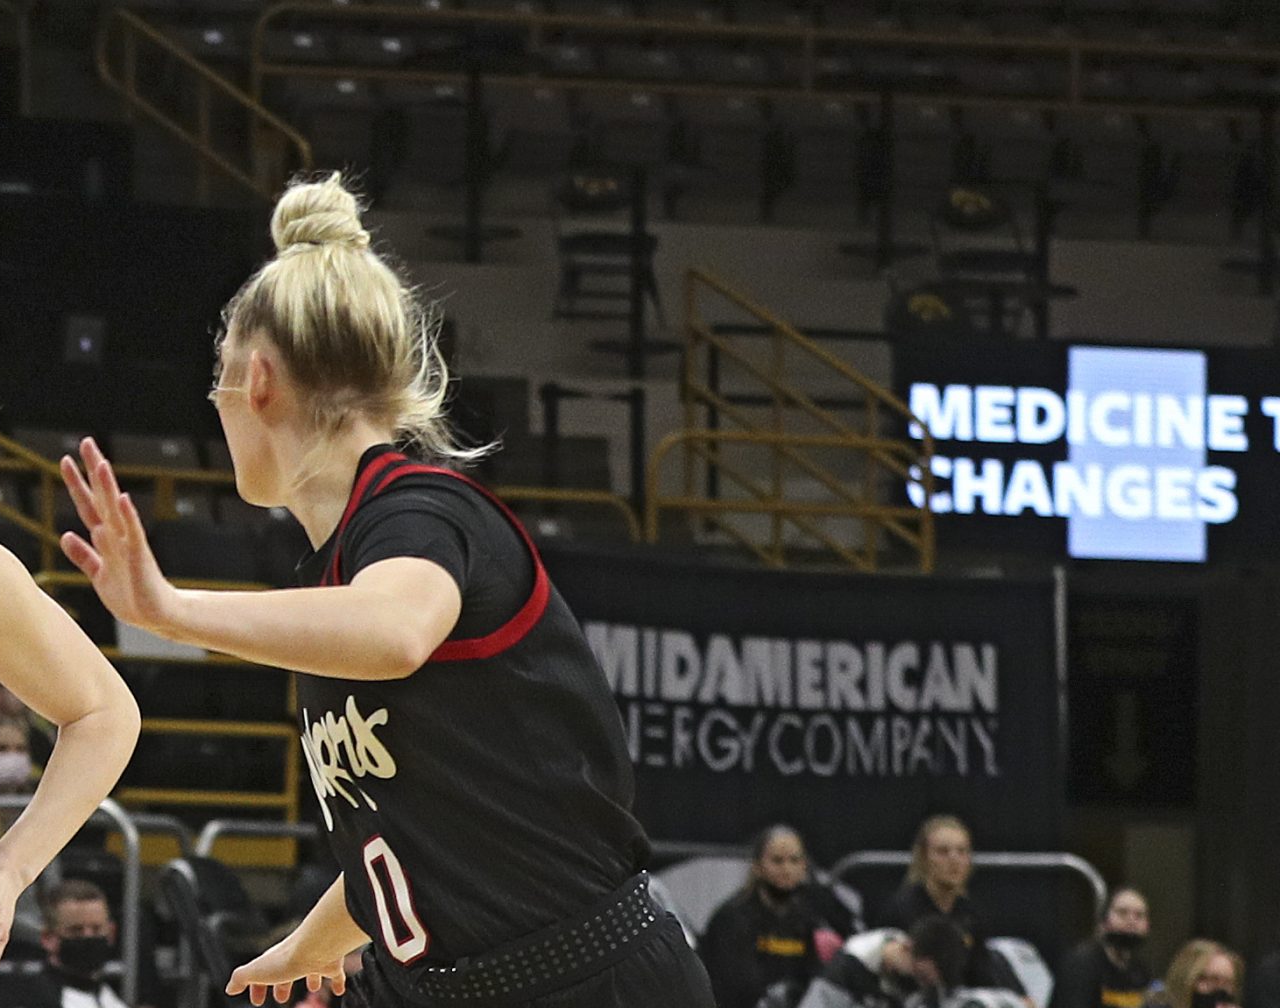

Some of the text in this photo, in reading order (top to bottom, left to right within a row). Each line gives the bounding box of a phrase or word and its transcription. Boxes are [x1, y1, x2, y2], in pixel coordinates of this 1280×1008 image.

[908, 383, 1249, 453] MEDICINE
[907, 453, 1238, 525] CHANGES
[767, 712, 1000, 778] COMPANY
[364, 832, 430, 966] 0
